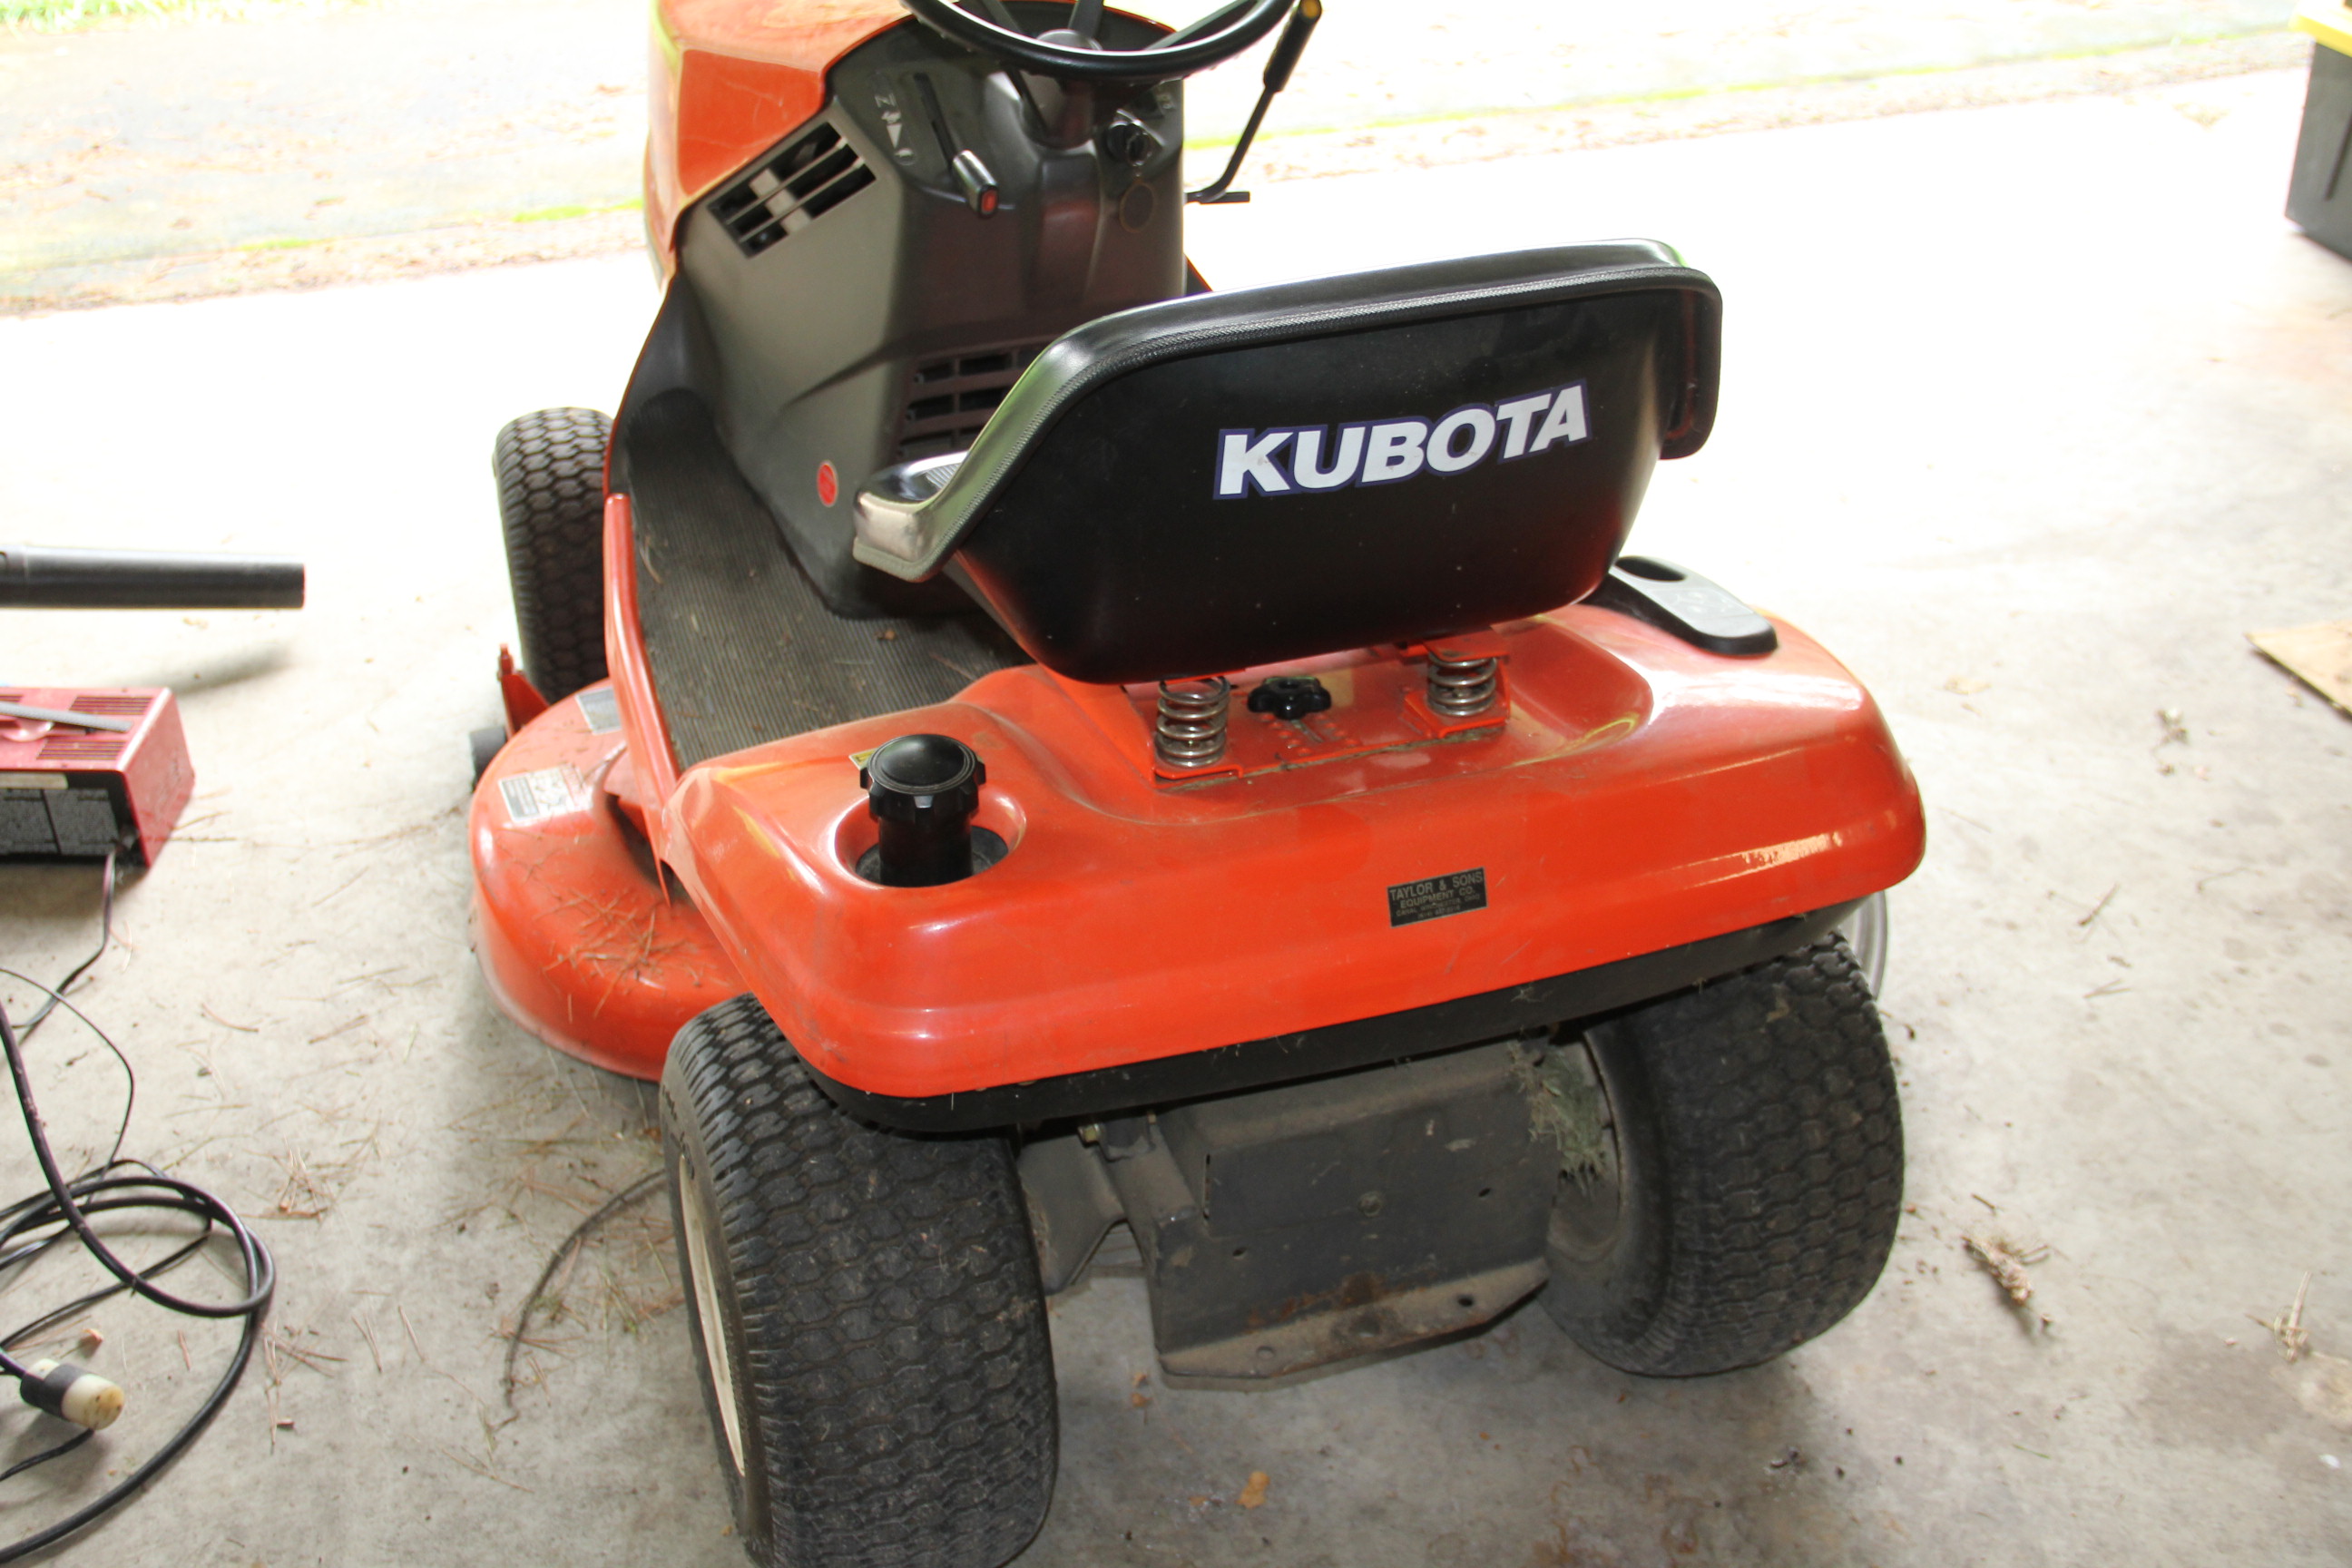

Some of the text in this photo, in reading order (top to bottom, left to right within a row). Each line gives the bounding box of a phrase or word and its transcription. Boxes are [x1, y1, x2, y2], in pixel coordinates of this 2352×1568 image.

[1216, 381, 1590, 497] KUBOTA
[1389, 871, 1483, 901] TAYLOR & SONS
[1400, 886, 1475, 908] EQUIPMENT CO.
